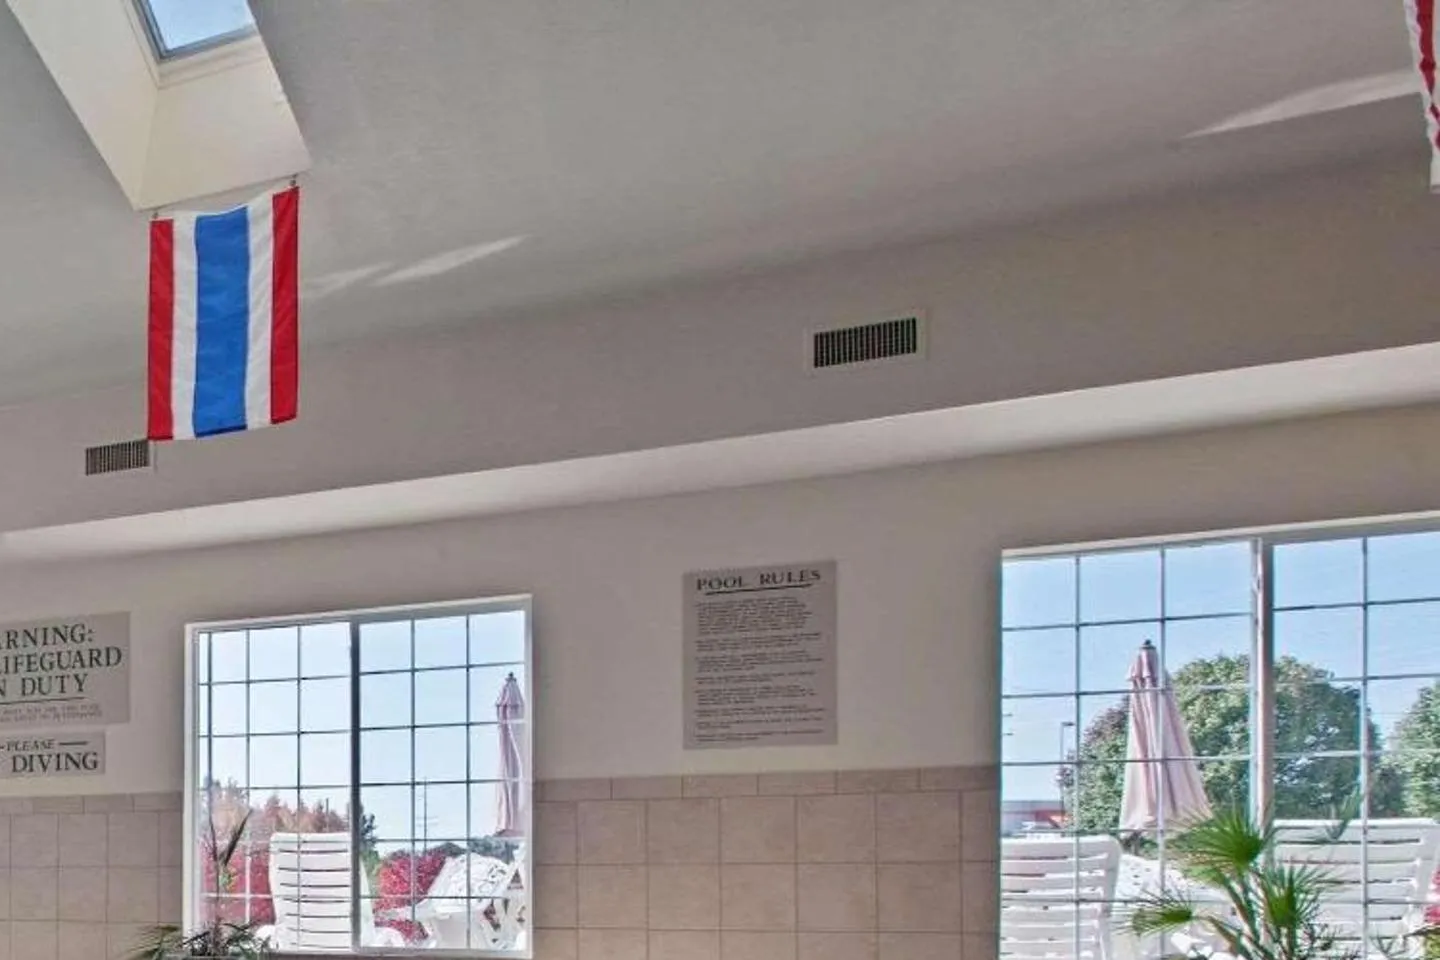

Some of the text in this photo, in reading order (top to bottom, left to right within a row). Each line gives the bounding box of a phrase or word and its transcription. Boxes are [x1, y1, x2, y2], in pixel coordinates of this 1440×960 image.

[696, 569, 821, 592] POOL RULES
[21, 673, 88, 697] DUTY
[6, 739, 55, 752] PLEASE
[12, 751, 98, 774] DIVING
